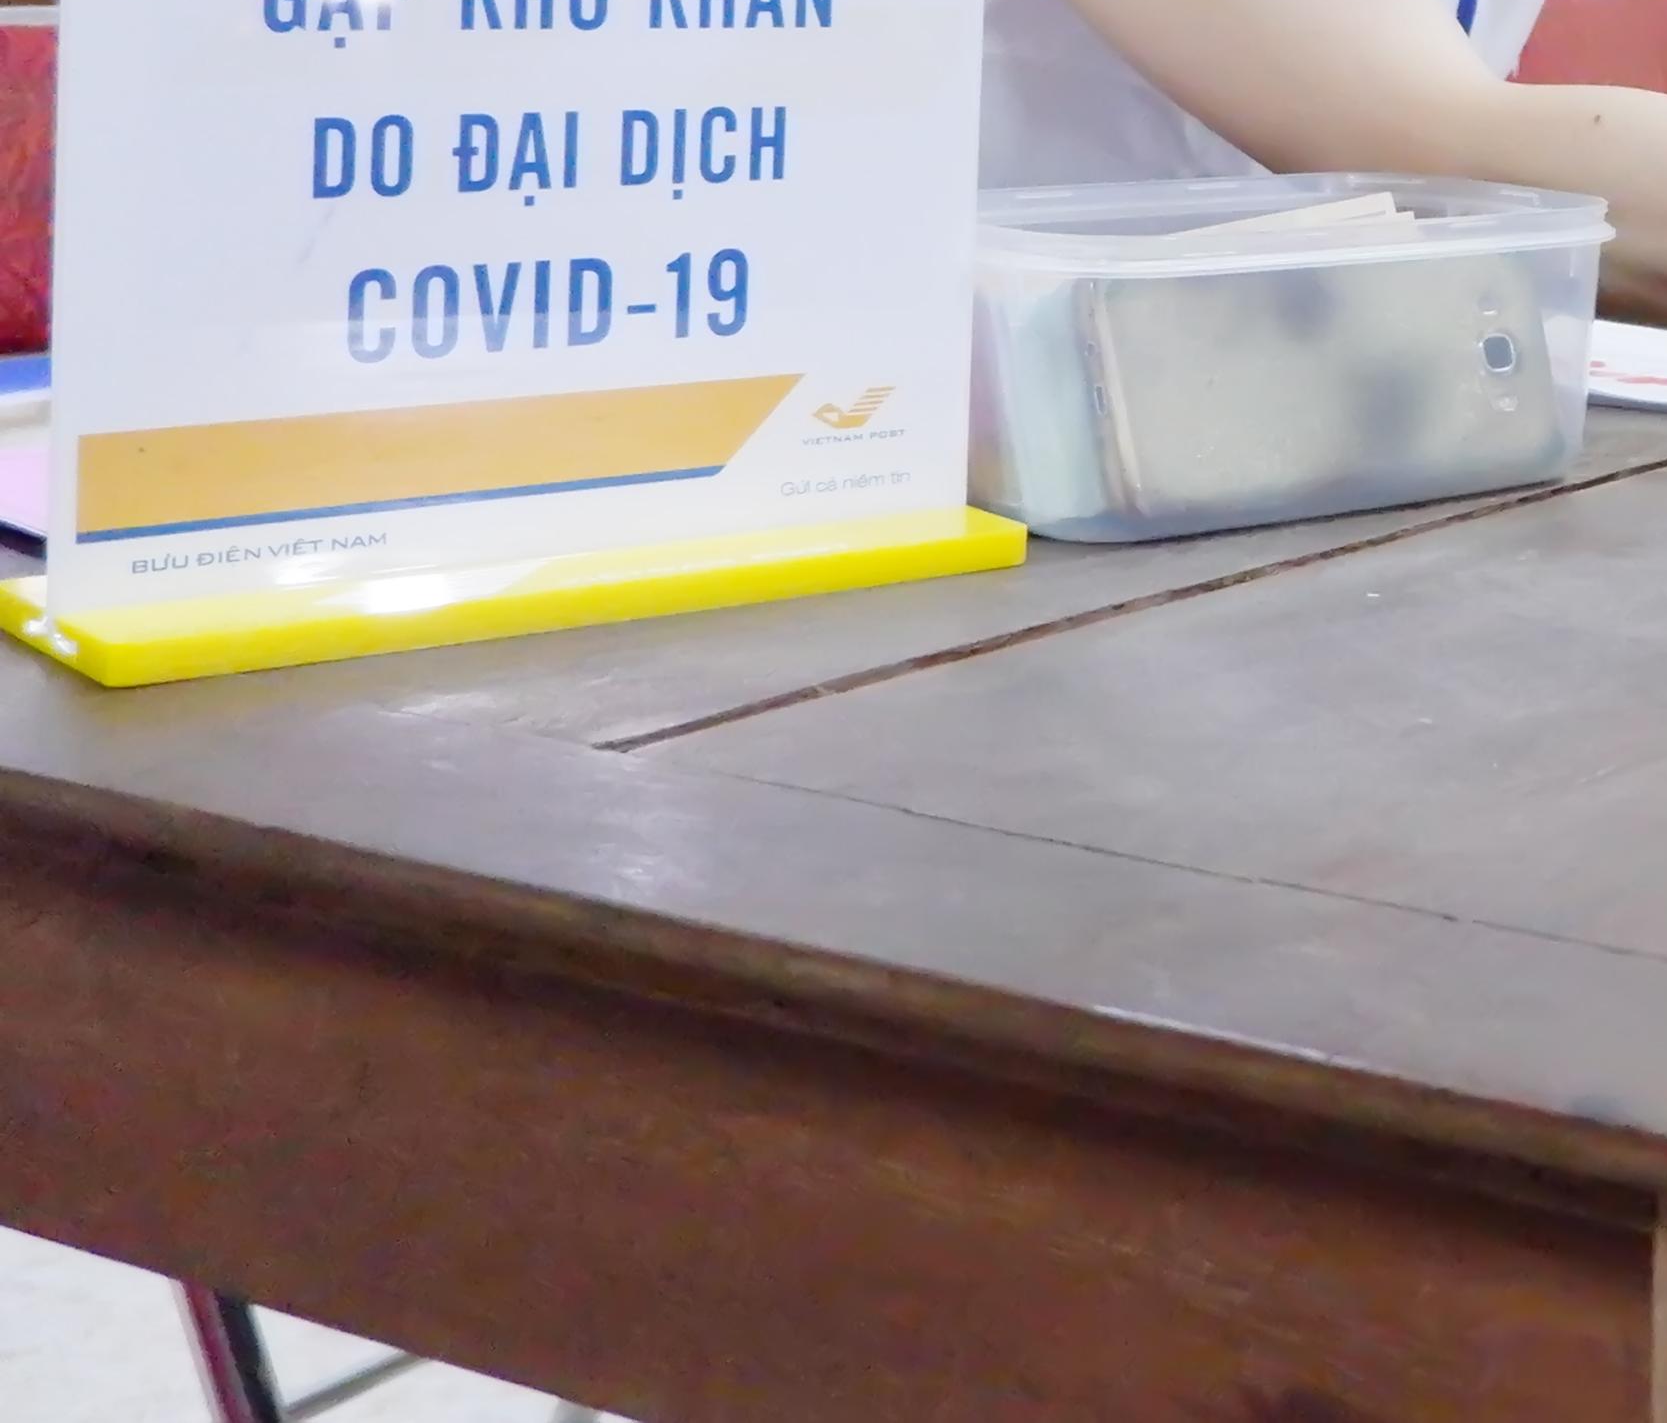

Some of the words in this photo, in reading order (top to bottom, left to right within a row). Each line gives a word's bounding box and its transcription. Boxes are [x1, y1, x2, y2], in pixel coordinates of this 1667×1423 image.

[311, 113, 415, 200] DO
[450, 108, 580, 208] ĐẠI
[619, 103, 787, 202] DỊCH
[346, 247, 751, 364] COVID-19
[801, 433, 864, 446] VIETNAM
[869, 428, 906, 440] POST
[131, 553, 189, 575] BƯU
[330, 532, 388, 552] NAM
